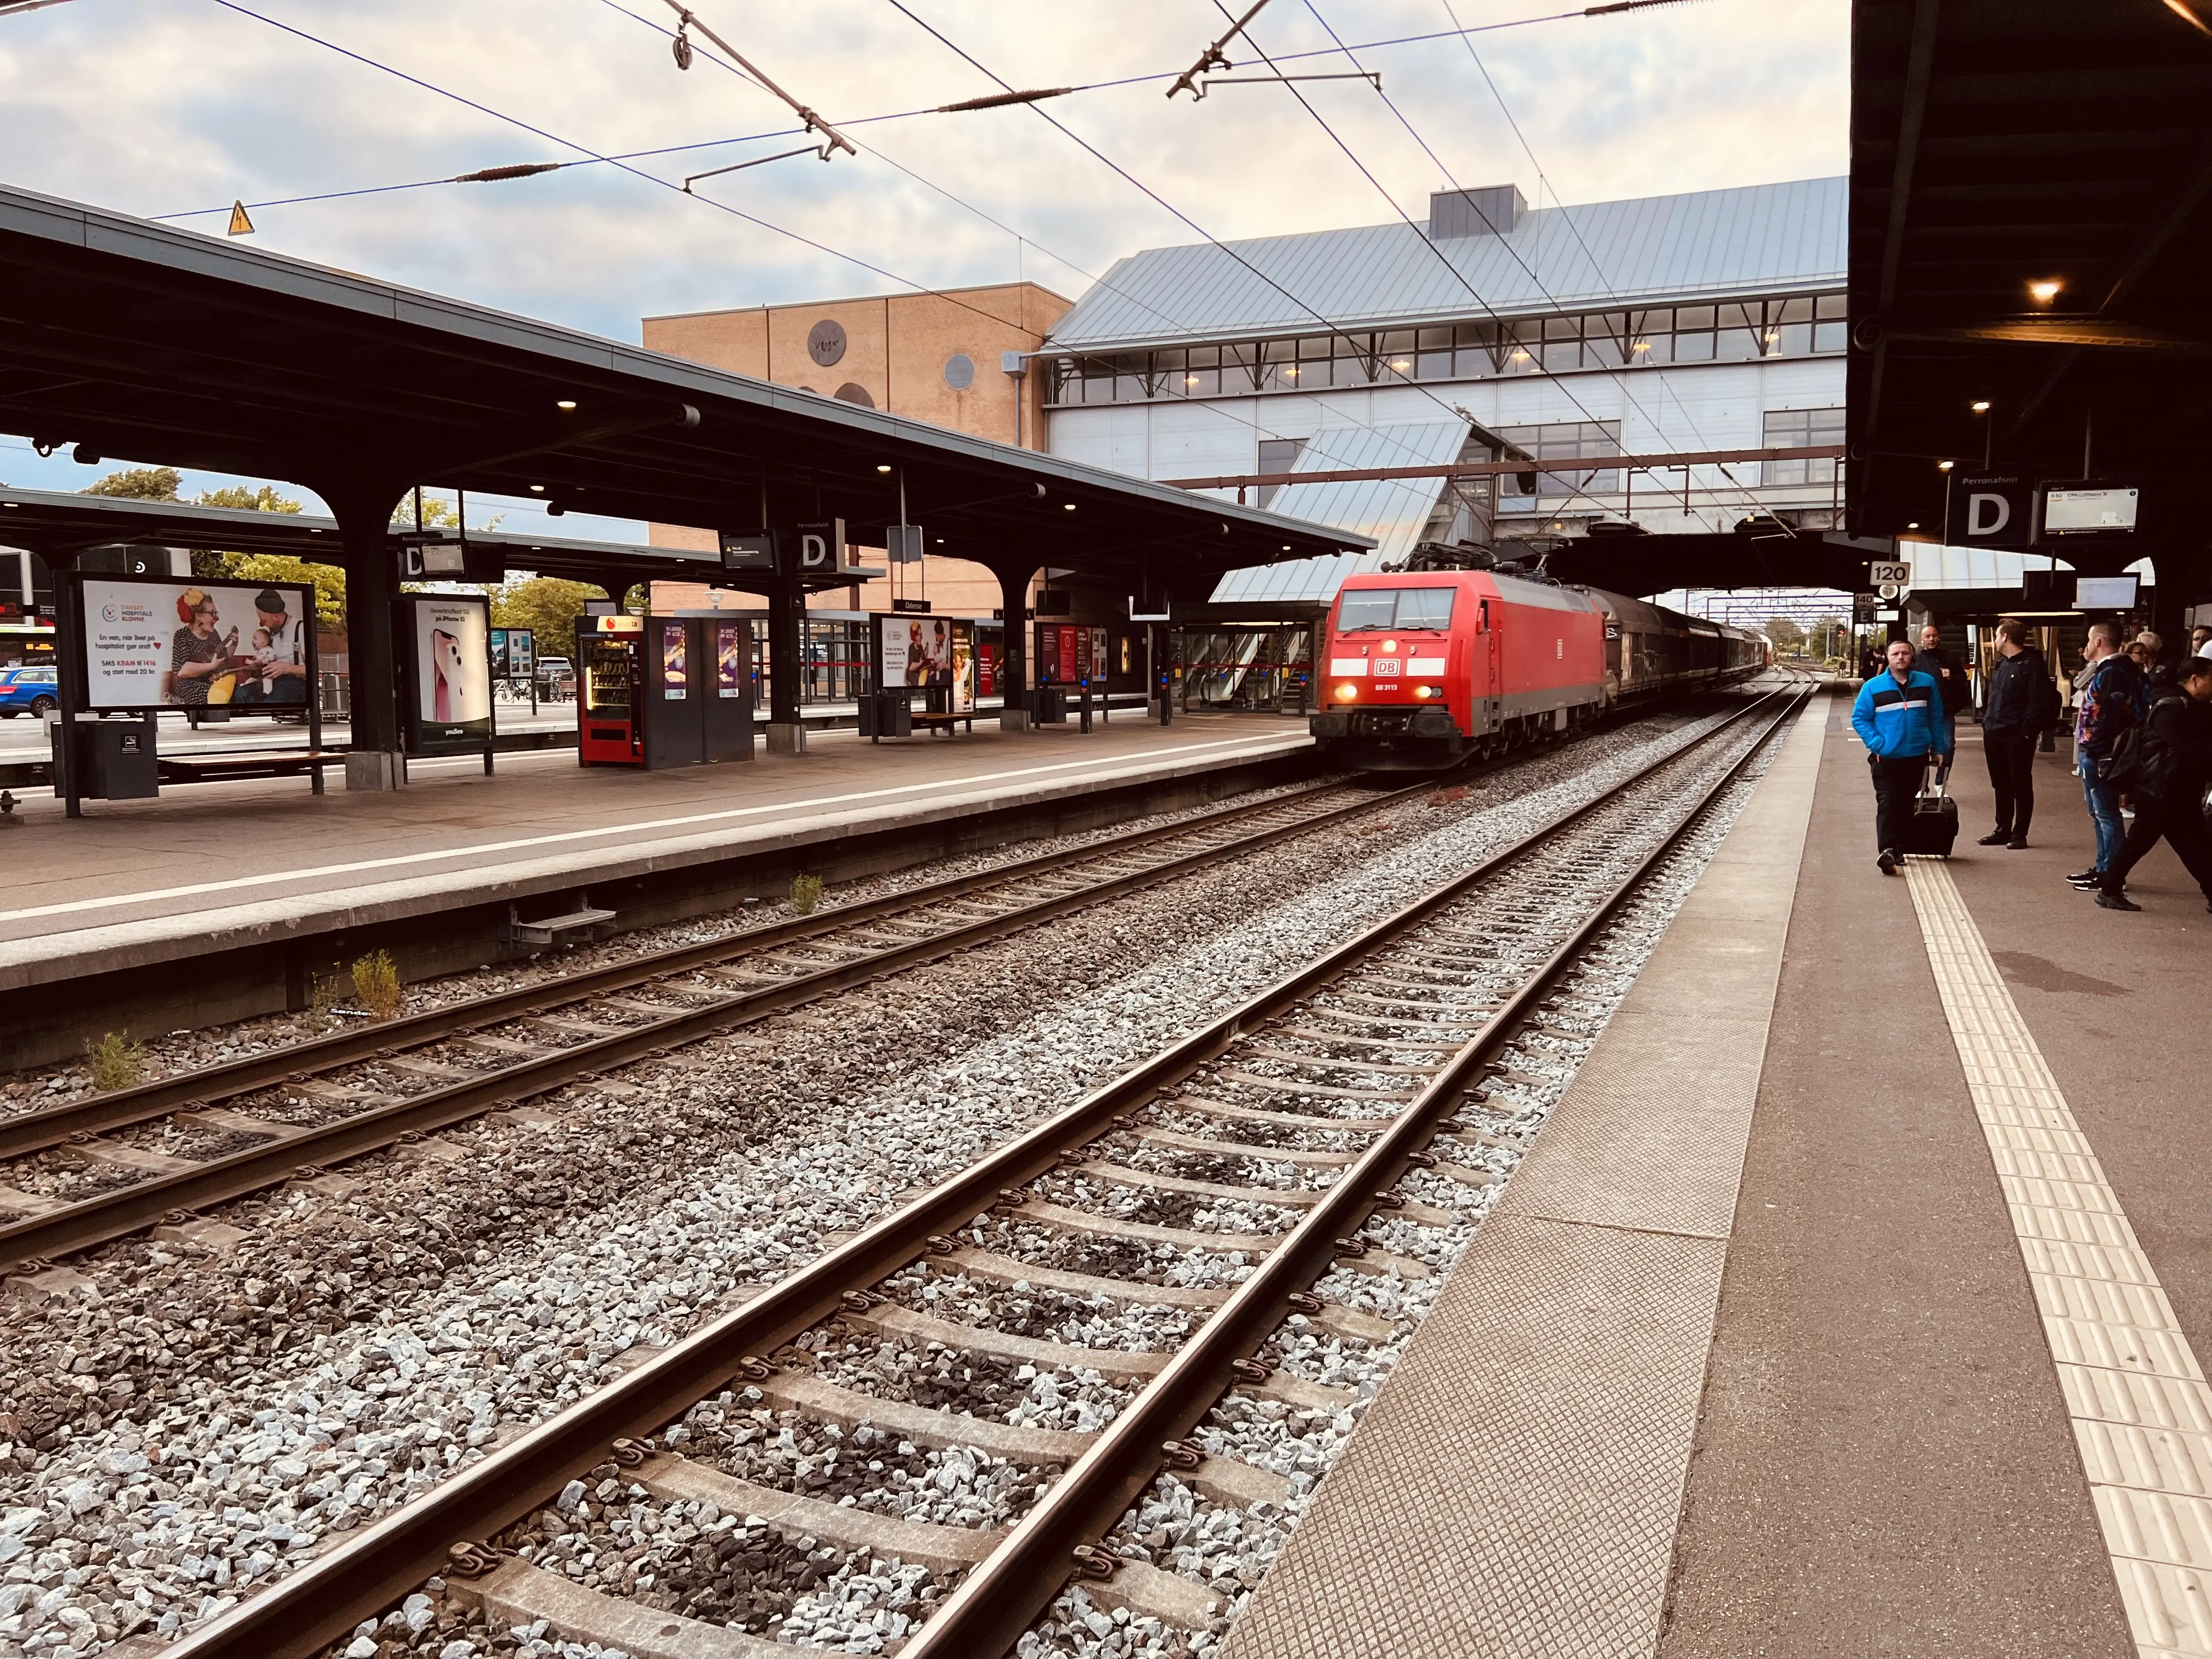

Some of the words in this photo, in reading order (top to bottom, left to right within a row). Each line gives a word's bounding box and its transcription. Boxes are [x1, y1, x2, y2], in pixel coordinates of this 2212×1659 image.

[1962, 476, 2018, 485] Perronafsnit
[1968, 493, 2010, 535] D
[803, 534, 826, 566] D
[407, 547, 422, 575] D
[1875, 566, 1906, 581] 120
[1856, 595, 1873, 603] 140
[905, 601, 922, 610] Odense
[1860, 611, 1869, 622] E
[1379, 663, 1395, 673] DB
